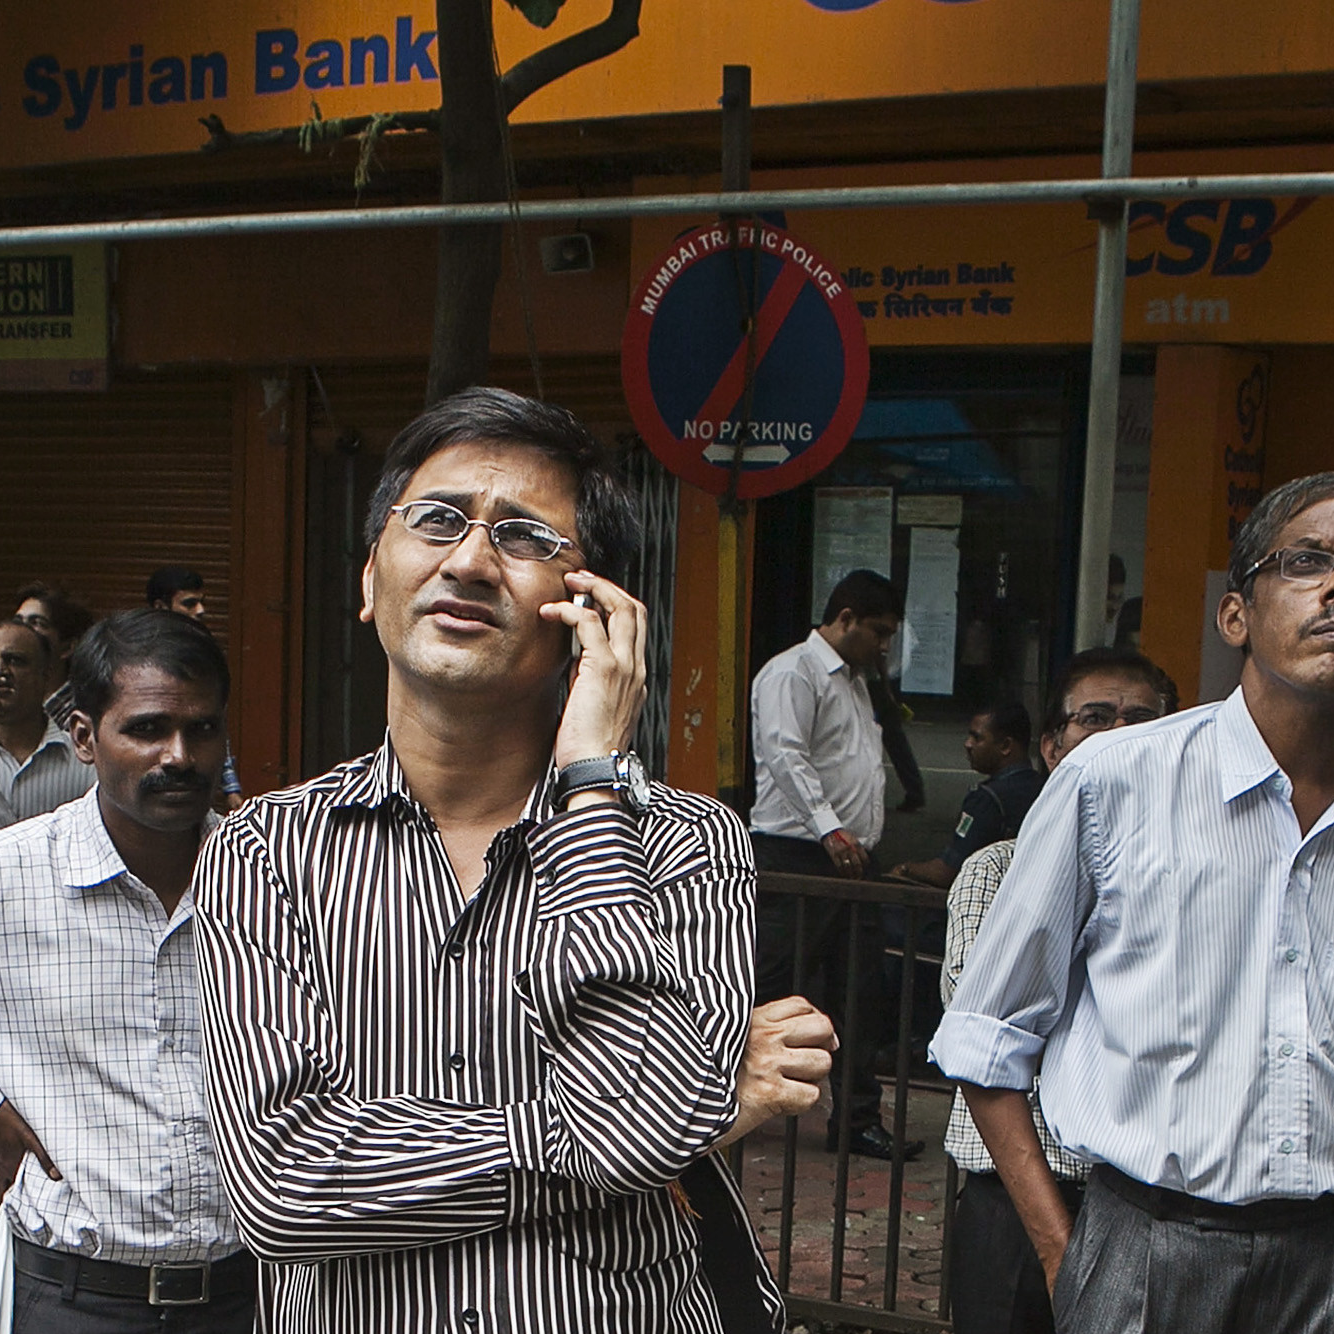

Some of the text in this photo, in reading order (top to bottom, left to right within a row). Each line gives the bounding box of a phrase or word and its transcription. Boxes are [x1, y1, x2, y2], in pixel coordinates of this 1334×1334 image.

[22, 44, 228, 132] Syrian
[255, 16, 438, 95] Bank
[1125, 201, 1277, 277] CSB
[640, 241, 698, 316] MUMBAI
[781, 238, 842, 299] POLICE
[881, 266, 949, 290] Syrian
[957, 262, 1014, 284] Bank
[1145, 294, 1230, 325] atm
[684, 420, 813, 441] NO PARKING
